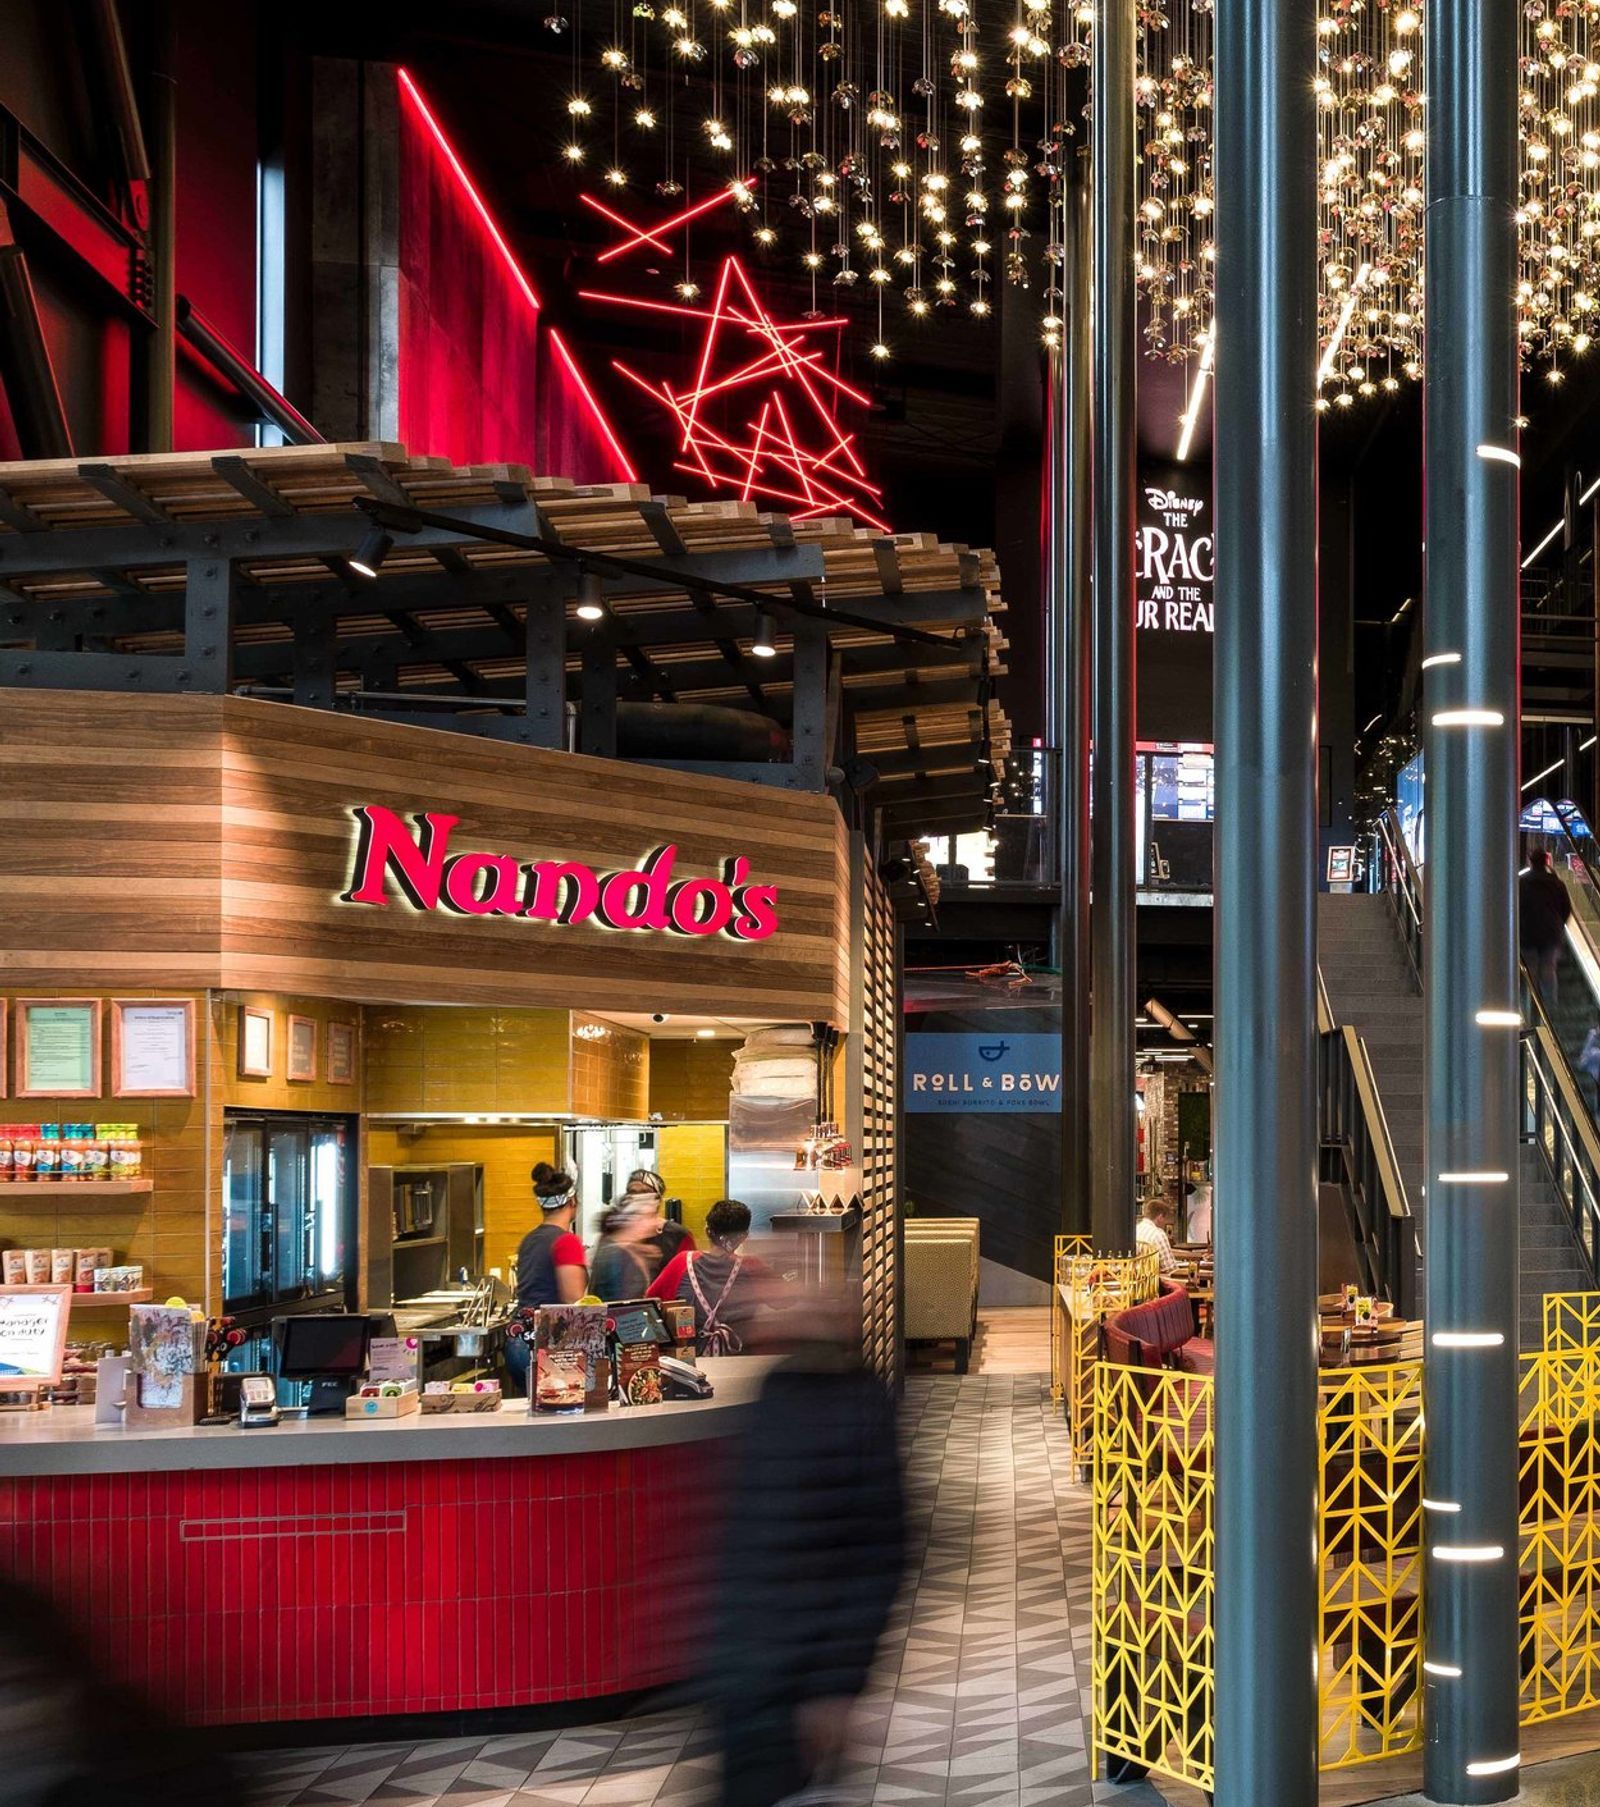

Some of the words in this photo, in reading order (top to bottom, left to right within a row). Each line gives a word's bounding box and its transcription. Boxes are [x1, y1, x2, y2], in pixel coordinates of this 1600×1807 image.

[1163, 513, 1188, 527] THE
[1136, 526, 1214, 584] RAC
[1151, 585, 1173, 599] AND
[1178, 587, 1201, 601] THE
[342, 805, 778, 940] Nando's
[981, 1077, 993, 1088] &
